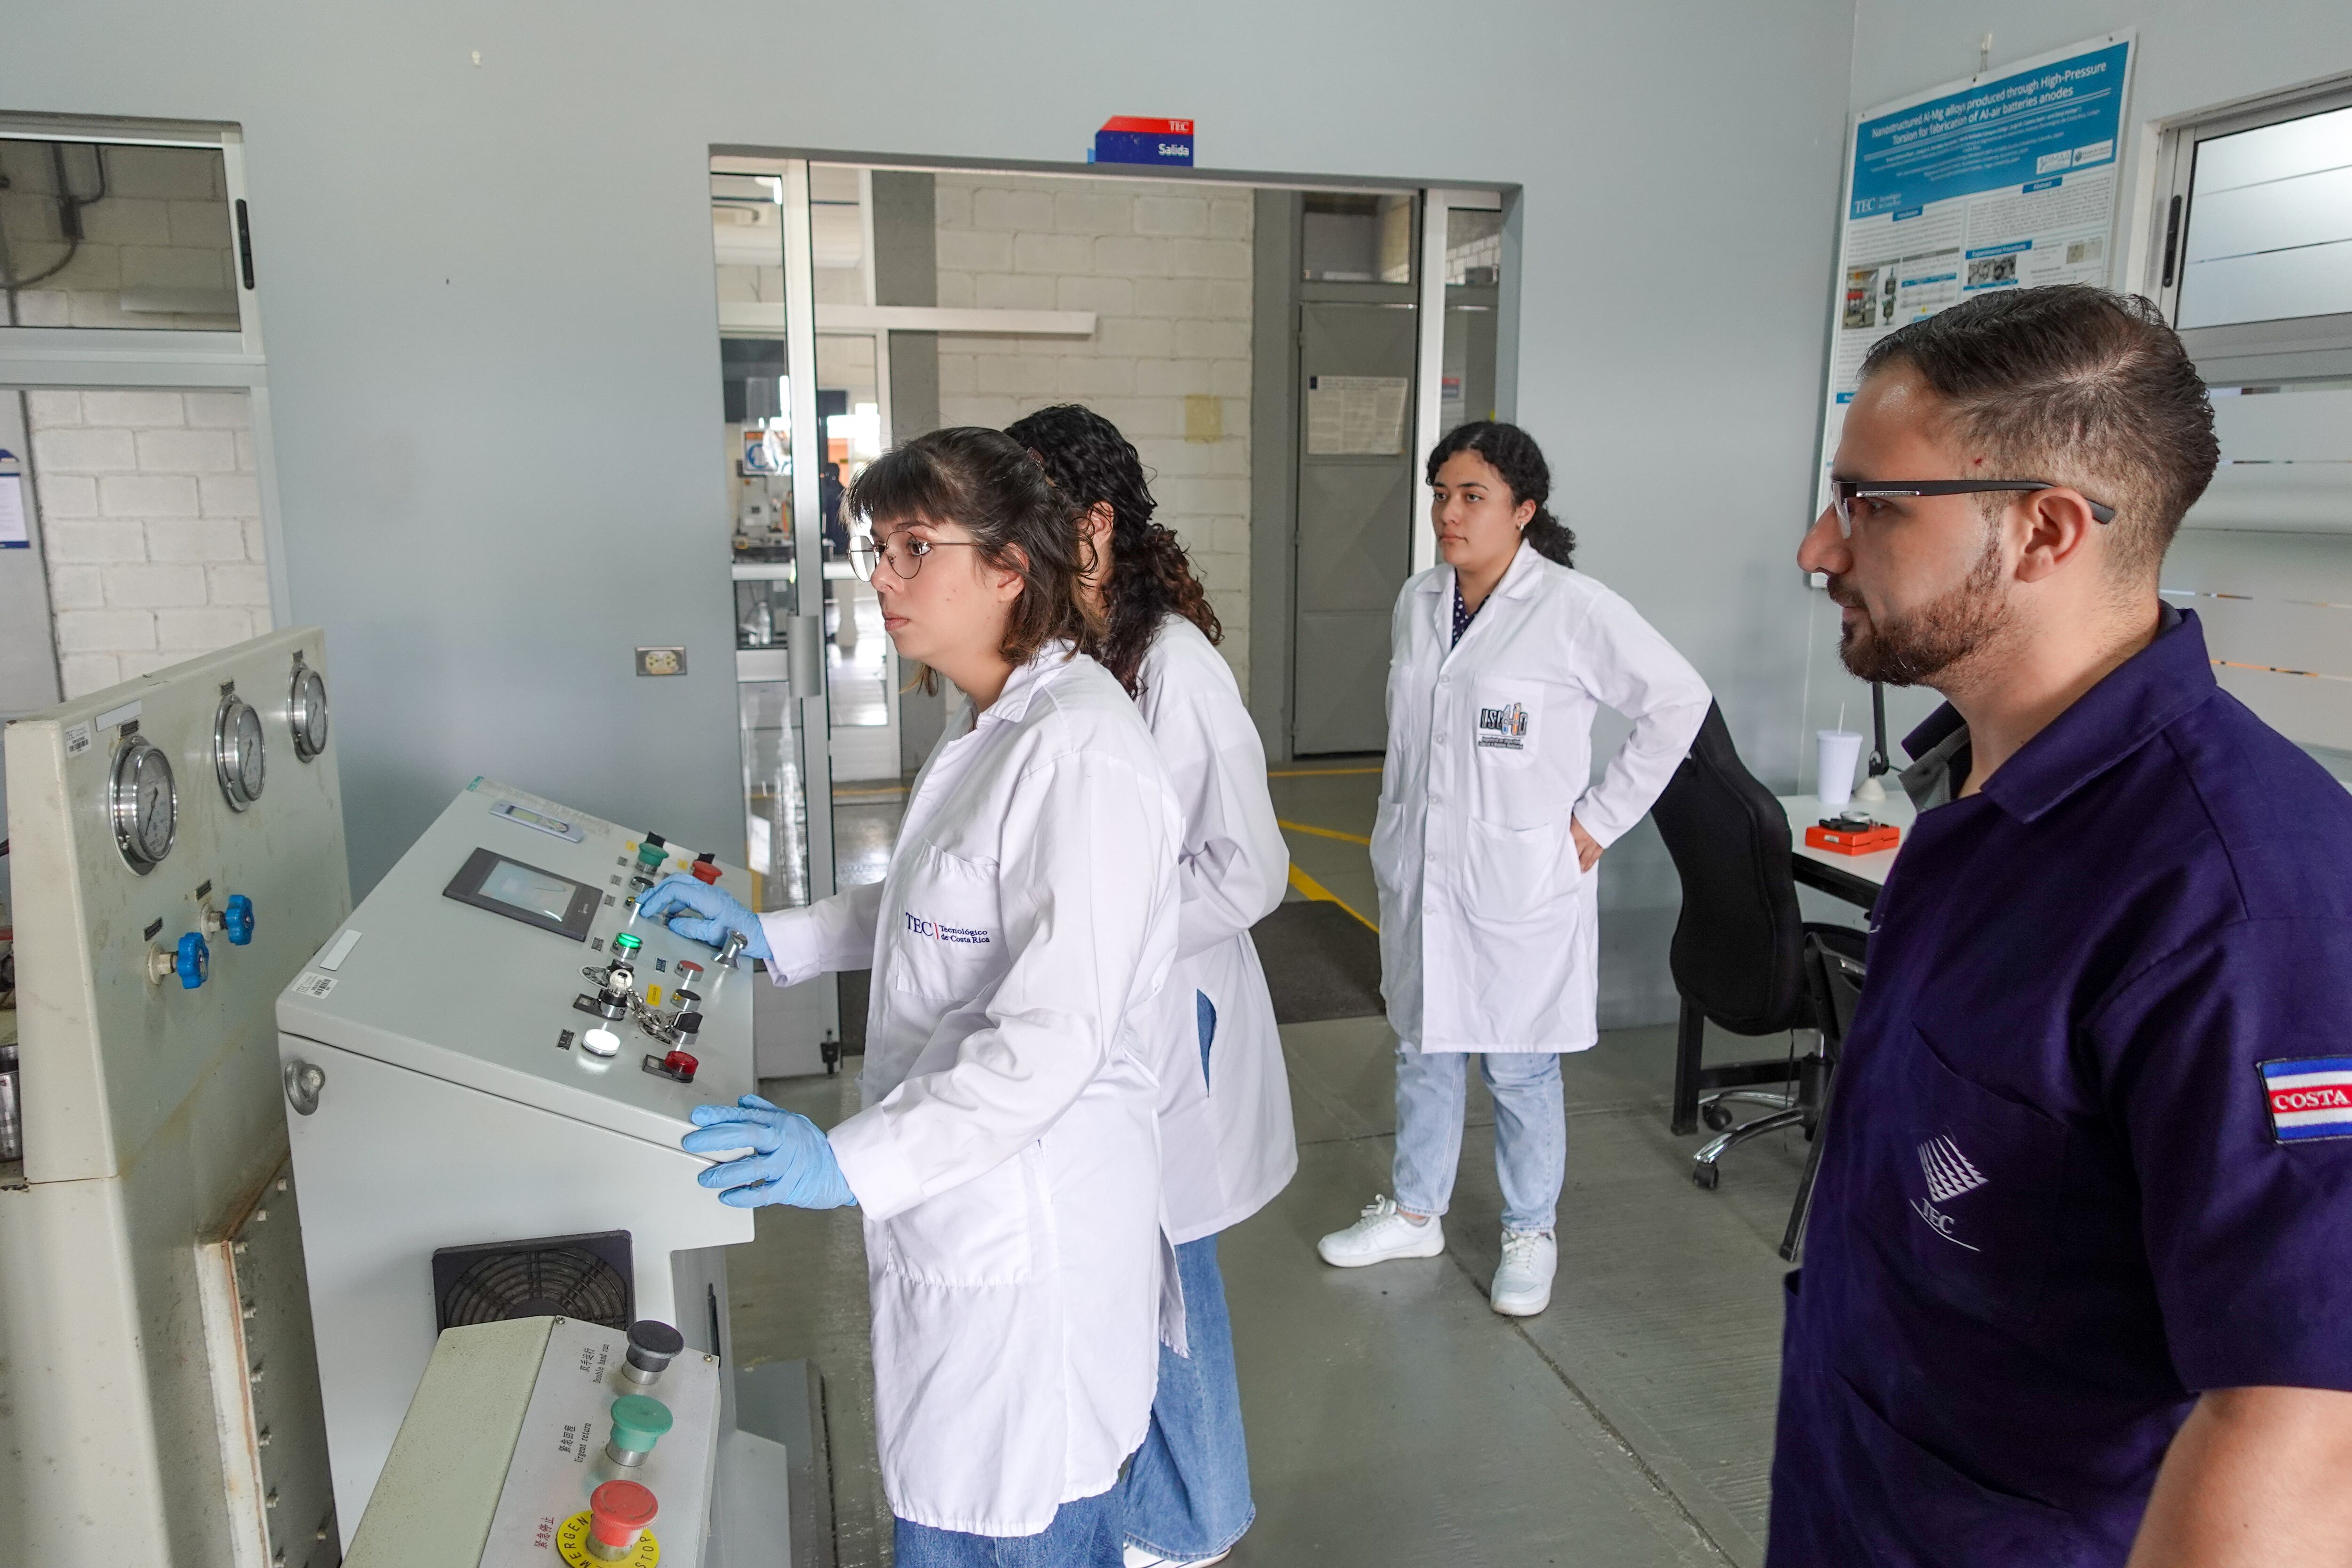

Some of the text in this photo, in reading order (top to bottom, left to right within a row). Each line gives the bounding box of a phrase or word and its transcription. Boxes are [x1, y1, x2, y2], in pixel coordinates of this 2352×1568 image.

[1967, 88, 2006, 111] produced
[2006, 79, 2039, 96] through
[2041, 62, 2107, 88] High-Pressure
[1168, 120, 1189, 131] TEC
[1892, 130, 1918, 145] Torsion
[1929, 116, 1967, 135] fabrication
[1968, 111, 1979, 123] of
[1979, 106, 2002, 121] Al-air
[2002, 96, 2038, 115] batteries
[2040, 86, 2074, 103] anodes
[1158, 143, 1189, 157] Salida
[1854, 198, 1876, 214] TEC
[906, 912, 933, 936] TEC
[939, 925, 988, 936] Tecnológico
[2273, 1089, 2351, 1110] COSTA
[1922, 1197, 1955, 1234] TEC
[580, 1348, 595, 1373] 双手运行
[597, 1353, 607, 1365] hand
[593, 1366, 604, 1384] Double
[558, 1425, 576, 1454] 紧急回程
[573, 1423, 592, 1463] Urgent return
[534, 1516, 554, 1549] 紧急停止
[635, 1536, 655, 1568] STOP
